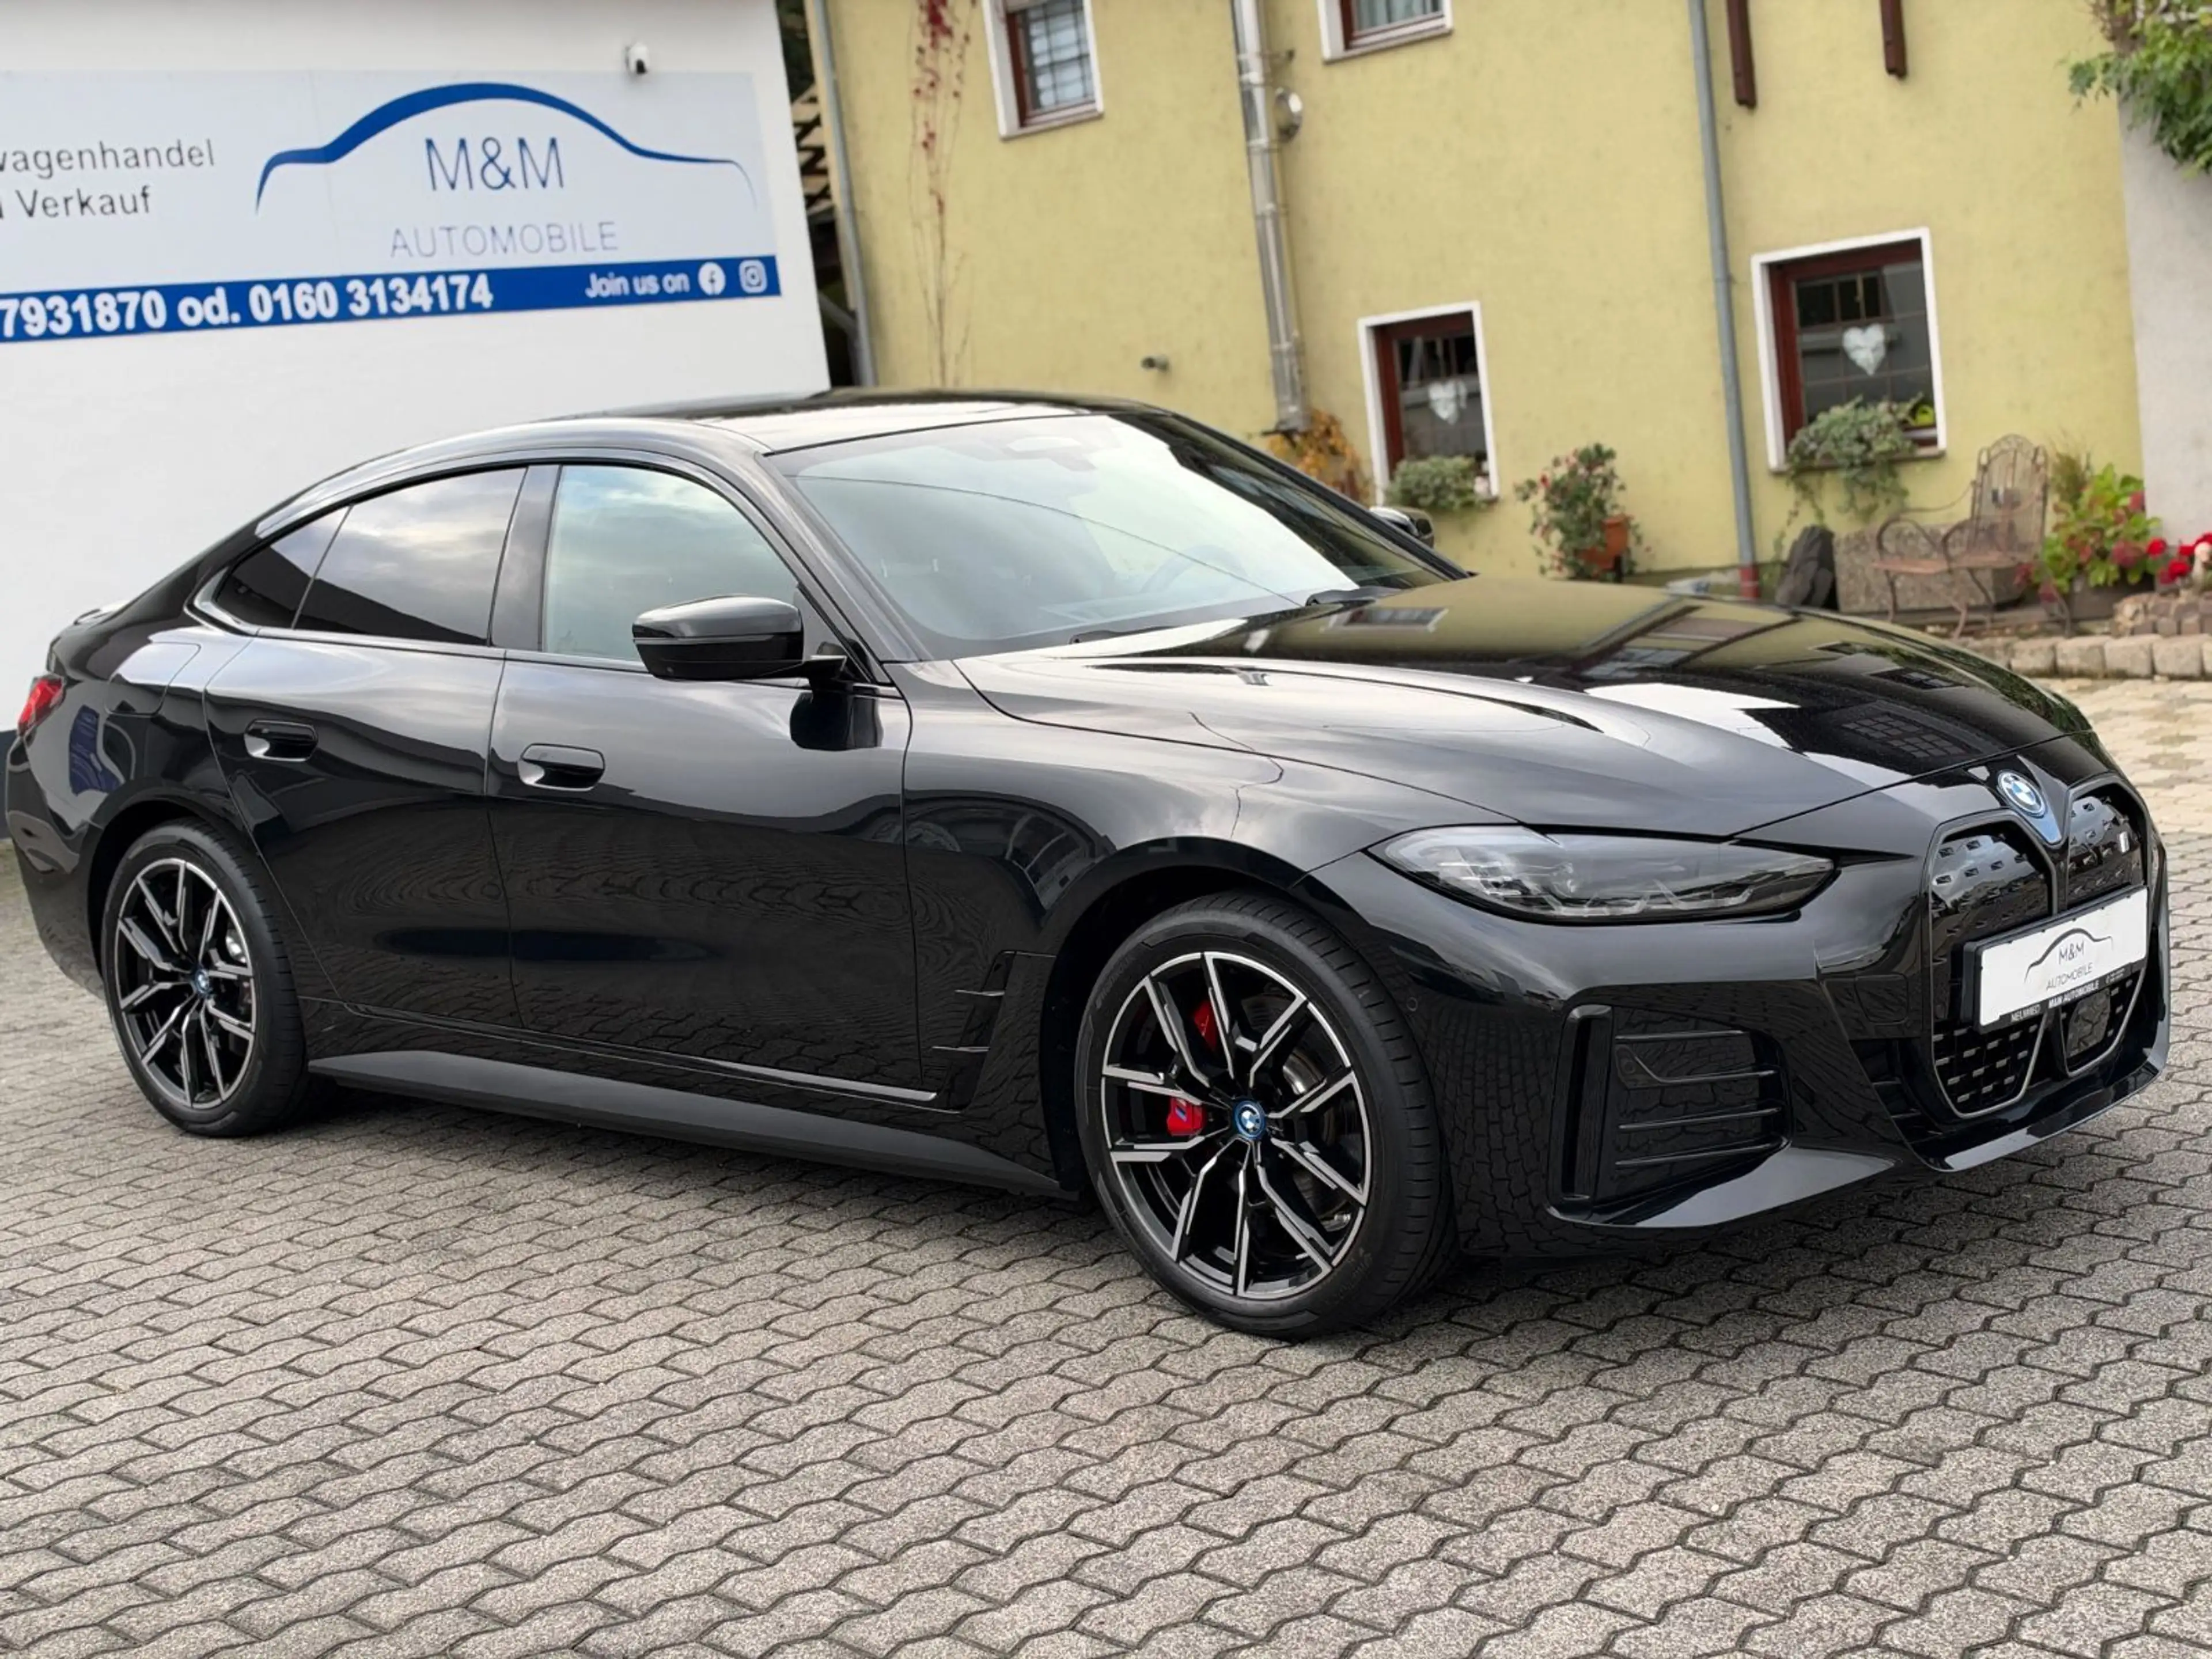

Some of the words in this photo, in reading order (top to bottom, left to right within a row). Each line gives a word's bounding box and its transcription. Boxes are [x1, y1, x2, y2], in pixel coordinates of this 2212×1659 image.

[424, 137, 564, 191] M&M
[15, 184, 150, 218] Verkauf
[391, 221, 618, 257] AUTOMOBILE
[585, 271, 630, 298] Join
[632, 274, 660, 296] us
[662, 272, 690, 294] on
[0, 290, 167, 338] 7931870
[177, 286, 241, 327] od.
[249, 281, 339, 322] 0160
[347, 273, 493, 316] 3134174
[2058, 940, 2085, 965] M&M
[2046, 962, 2093, 991] AUTOMOBILE
